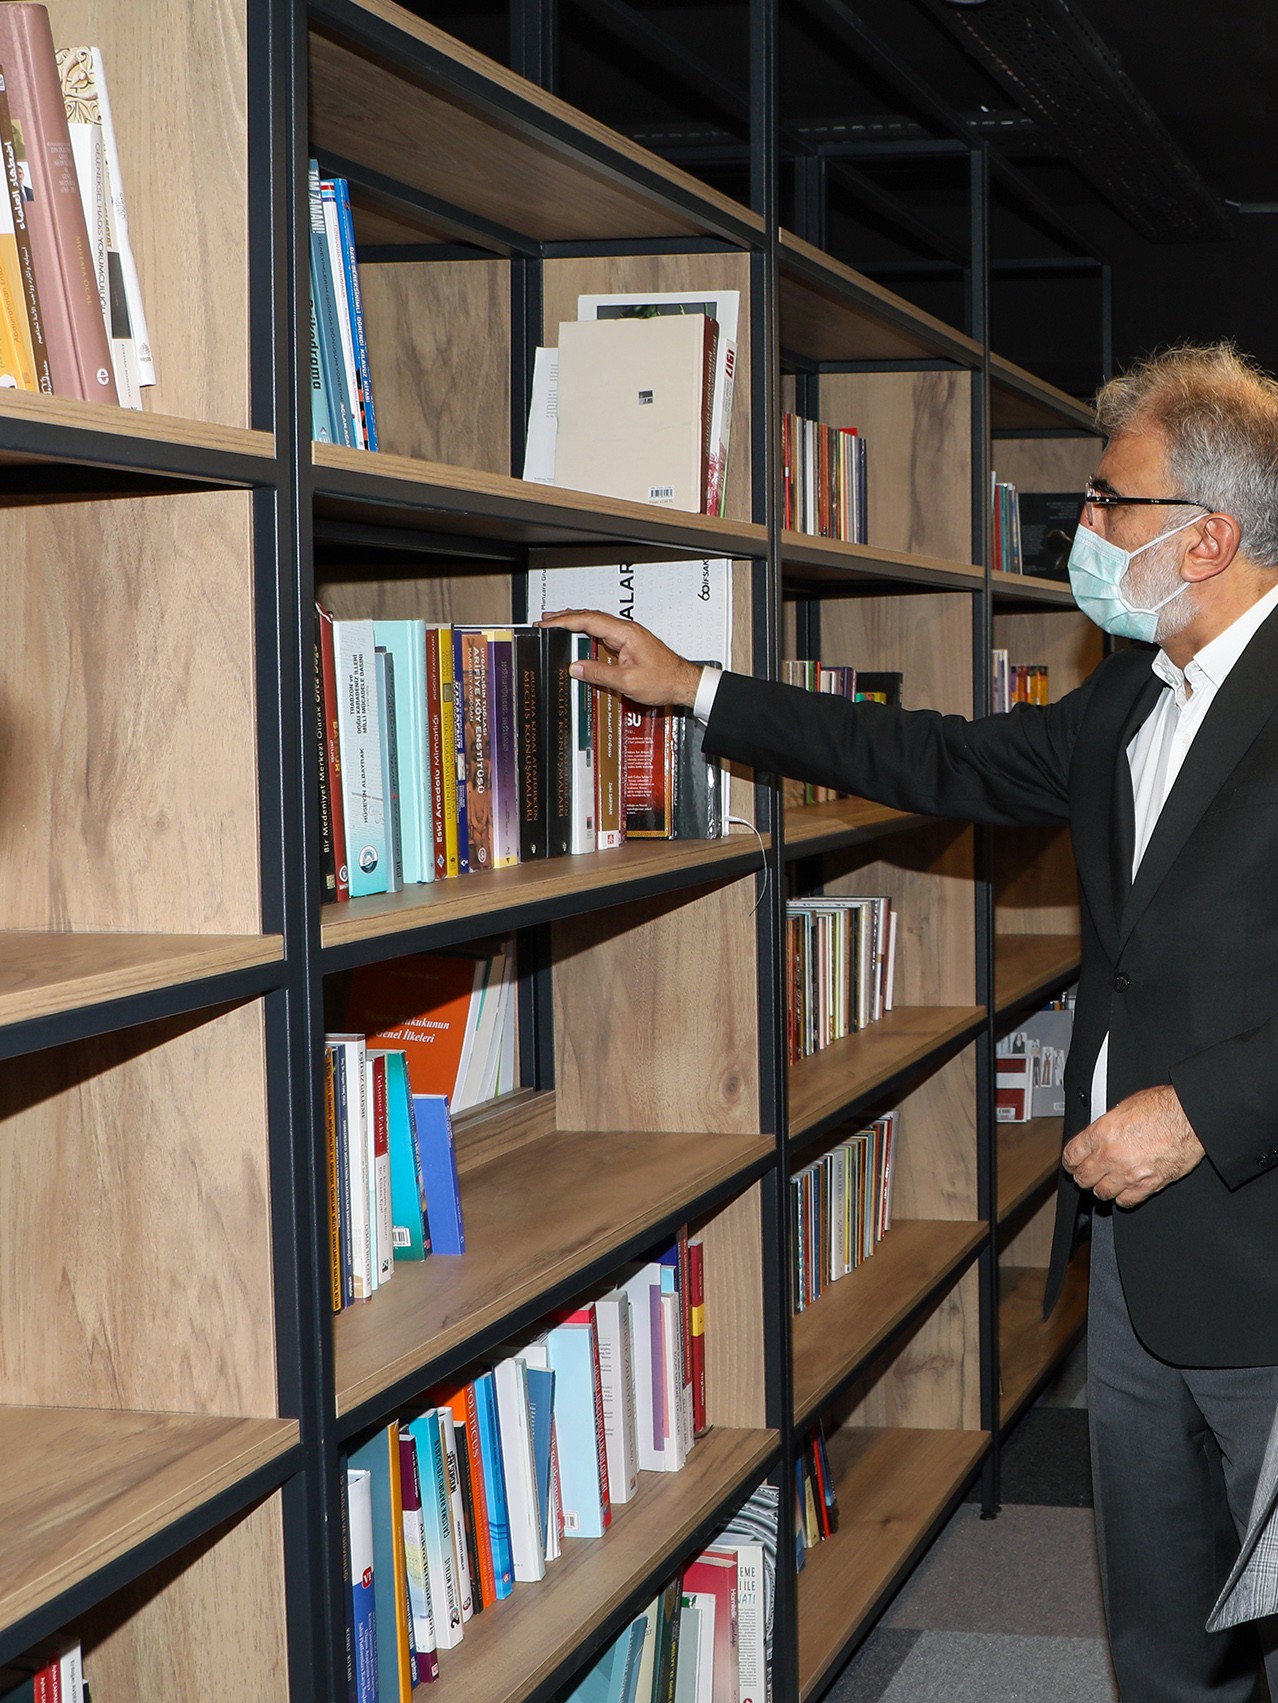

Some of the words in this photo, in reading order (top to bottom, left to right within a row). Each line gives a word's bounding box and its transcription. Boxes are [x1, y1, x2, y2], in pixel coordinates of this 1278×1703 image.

[95, 142, 103, 202] GELENEKSEL
[309, 170, 320, 191] TAM
[11, 188, 26, 230] العلماء
[725, 349, 735, 379] 1917
[473, 647, 481, 694] ARİFİYE
[318, 742, 326, 781] Merkezi
[359, 748, 367, 789] ALBAYRAK
[475, 726, 485, 793] ENSTİTÜSÜ
[524, 723, 533, 822] KONUŞMALARI
[319, 786, 329, 837] Medeniyet
[360, 790, 368, 823] HÜSEYİN
[400, 1016, 450, 1031] ukukunun
[402, 1029, 436, 1043] İlkeleri
[376, 1072, 386, 1112] Telomer
[437, 1479, 447, 1506] RAPORU
[440, 1507, 450, 1538] ÇALIŞMA
[738, 1567, 756, 1578] EME
[744, 1578, 756, 1591] İLE
